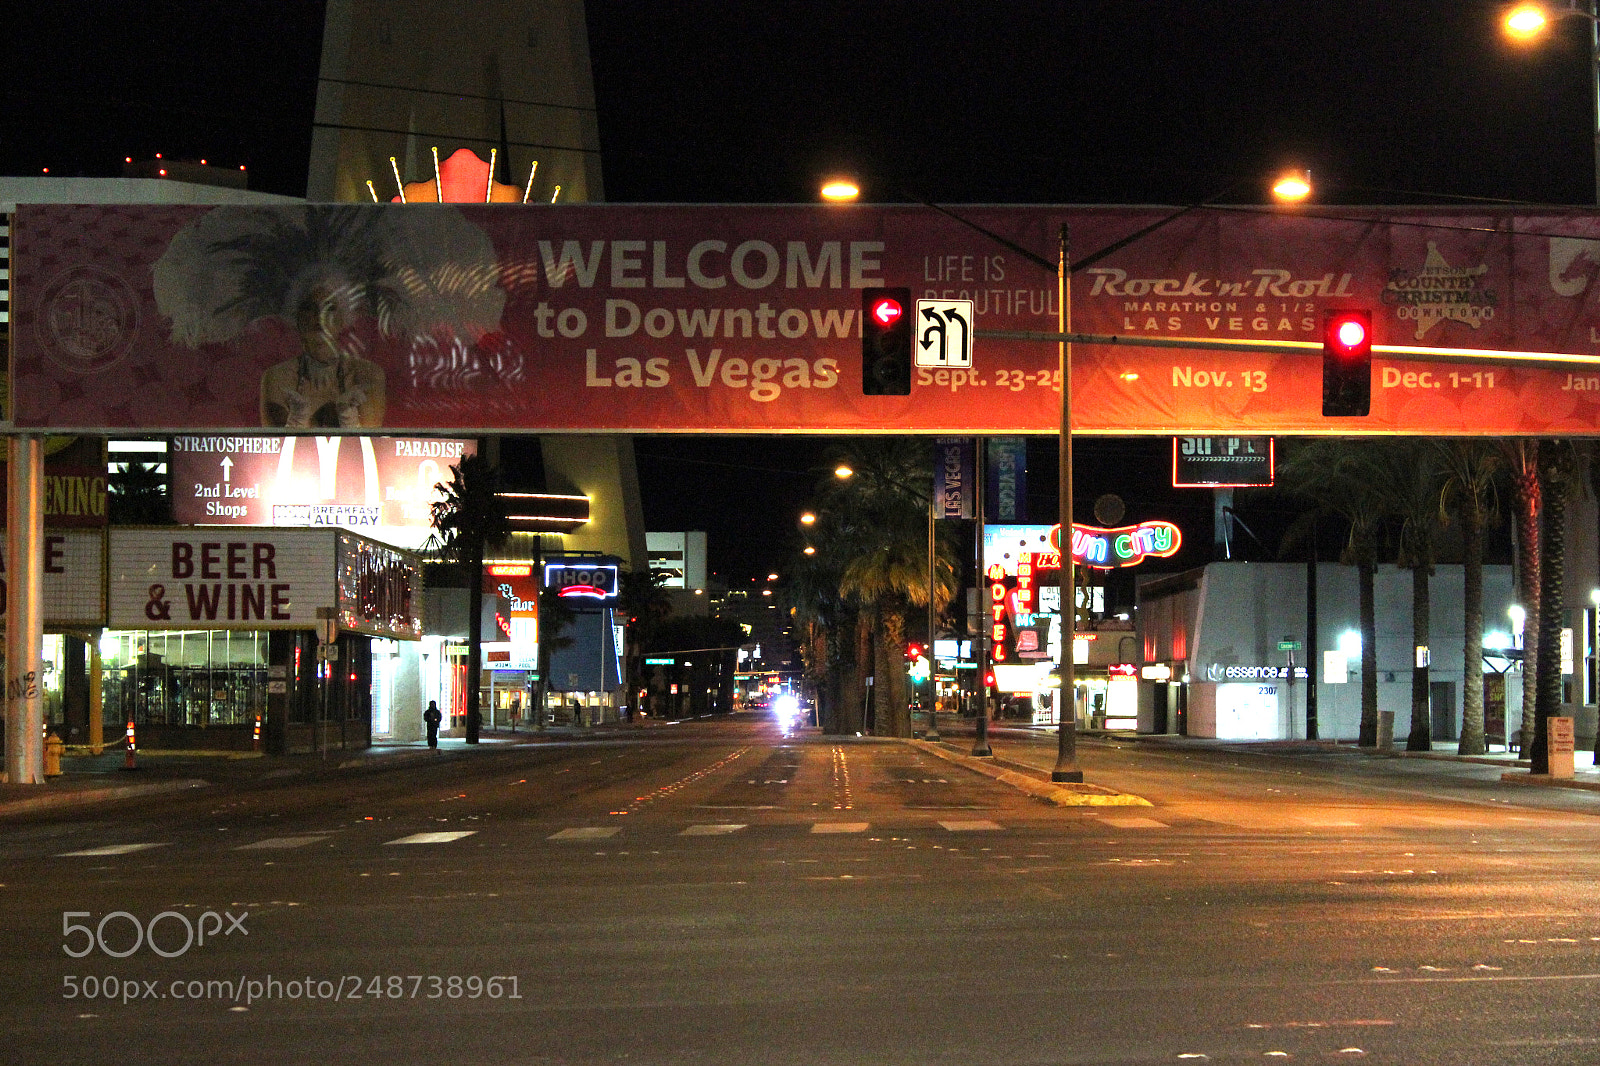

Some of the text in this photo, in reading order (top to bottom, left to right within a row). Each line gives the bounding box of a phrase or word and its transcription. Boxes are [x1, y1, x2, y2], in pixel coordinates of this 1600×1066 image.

[538, 240, 885, 289] WELCOME
[925, 256, 1005, 282] LIFE IS
[534, 299, 863, 338] to Downtow
[1124, 302, 1315, 313] MARATHON & 1/2
[1399, 307, 1492, 318] DOWNTOWN
[1124, 317, 1316, 331] LAS VEGAS
[586, 349, 838, 402] Las Vegas
[917, 367, 987, 392] Sept.
[1172, 366, 1268, 392] Nov. 13
[1382, 367, 1495, 388] Dec. 1-11
[174, 437, 281, 454] STRATOSPHERE
[395, 440, 464, 458] PARADISE
[43, 476, 106, 516] ENING
[195, 483, 260, 499] 2nd Level
[945, 491, 962, 516] LAS
[206, 501, 248, 519] Shops
[313, 505, 380, 515] BREAKFAST
[314, 515, 345, 526] ALL
[348, 515, 379, 526] DAY
[1058, 528, 1107, 562] UN
[172, 543, 277, 579] BEER
[1018, 552, 1031, 614] MOTEL
[145, 584, 291, 620] & WINE
[989, 564, 1006, 662] MOTEL
[1225, 666, 1279, 679] essence
[1258, 687, 1278, 695] 2307
